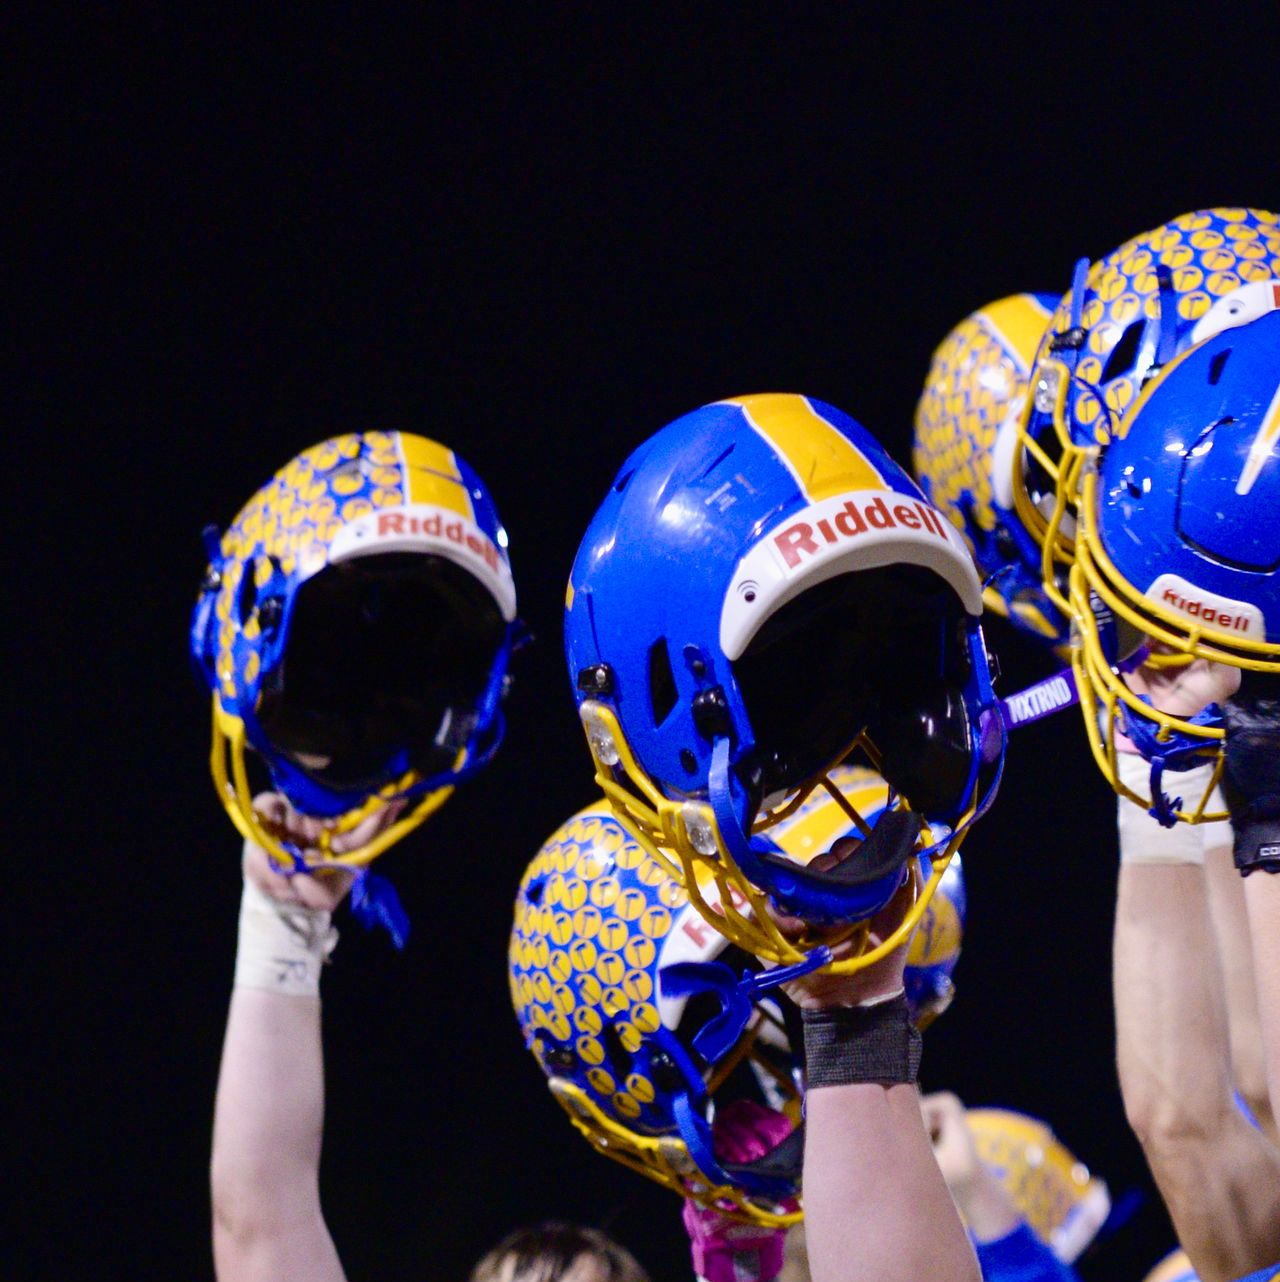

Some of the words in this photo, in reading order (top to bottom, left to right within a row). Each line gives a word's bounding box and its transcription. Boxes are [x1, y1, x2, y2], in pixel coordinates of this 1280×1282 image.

[377, 512, 500, 572] Riddell
[773, 497, 949, 570] Riddell
[1162, 588, 1250, 633] Riddell
[1006, 676, 1072, 724] NXTRND
